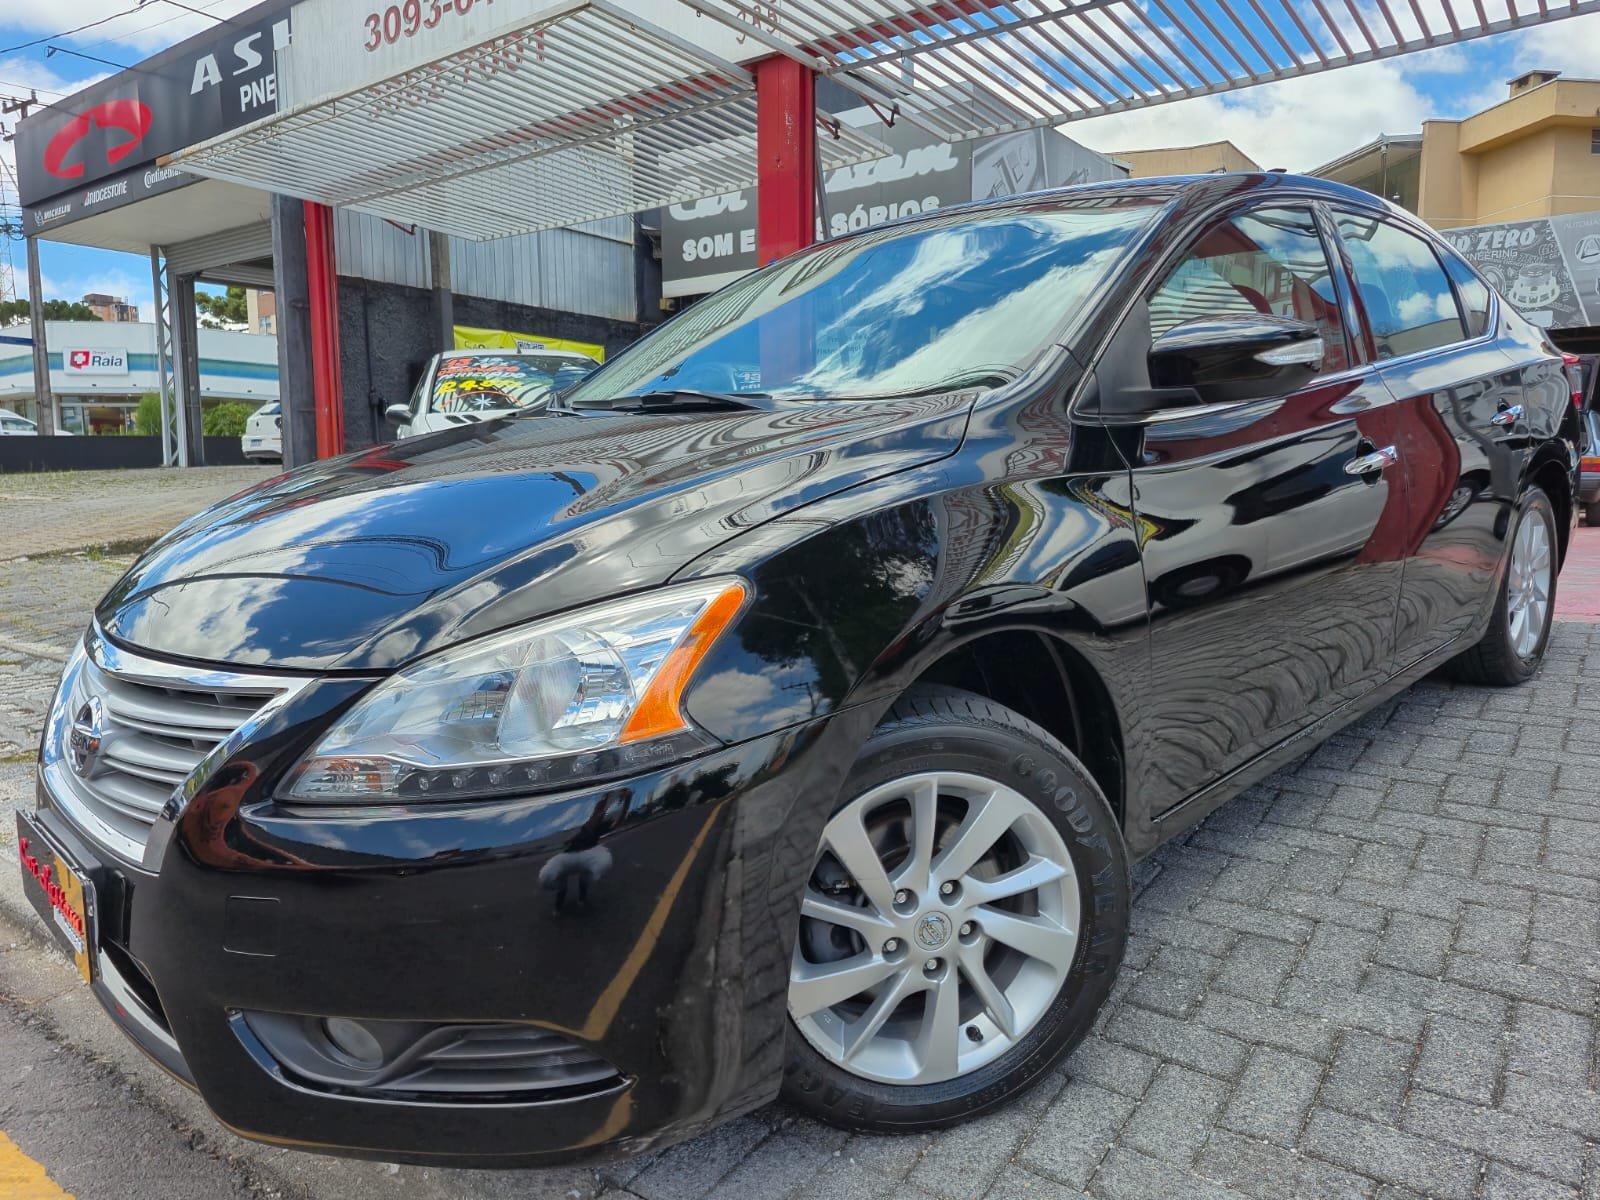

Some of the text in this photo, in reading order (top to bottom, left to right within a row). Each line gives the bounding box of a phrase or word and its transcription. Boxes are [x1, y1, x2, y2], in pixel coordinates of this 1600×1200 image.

[240, 73, 276, 112] PNE
[682, 232, 734, 262] SOM
[740, 228, 756, 254] E
[1476, 227, 1536, 251] ZERO
[91, 355, 123, 367] Raia
